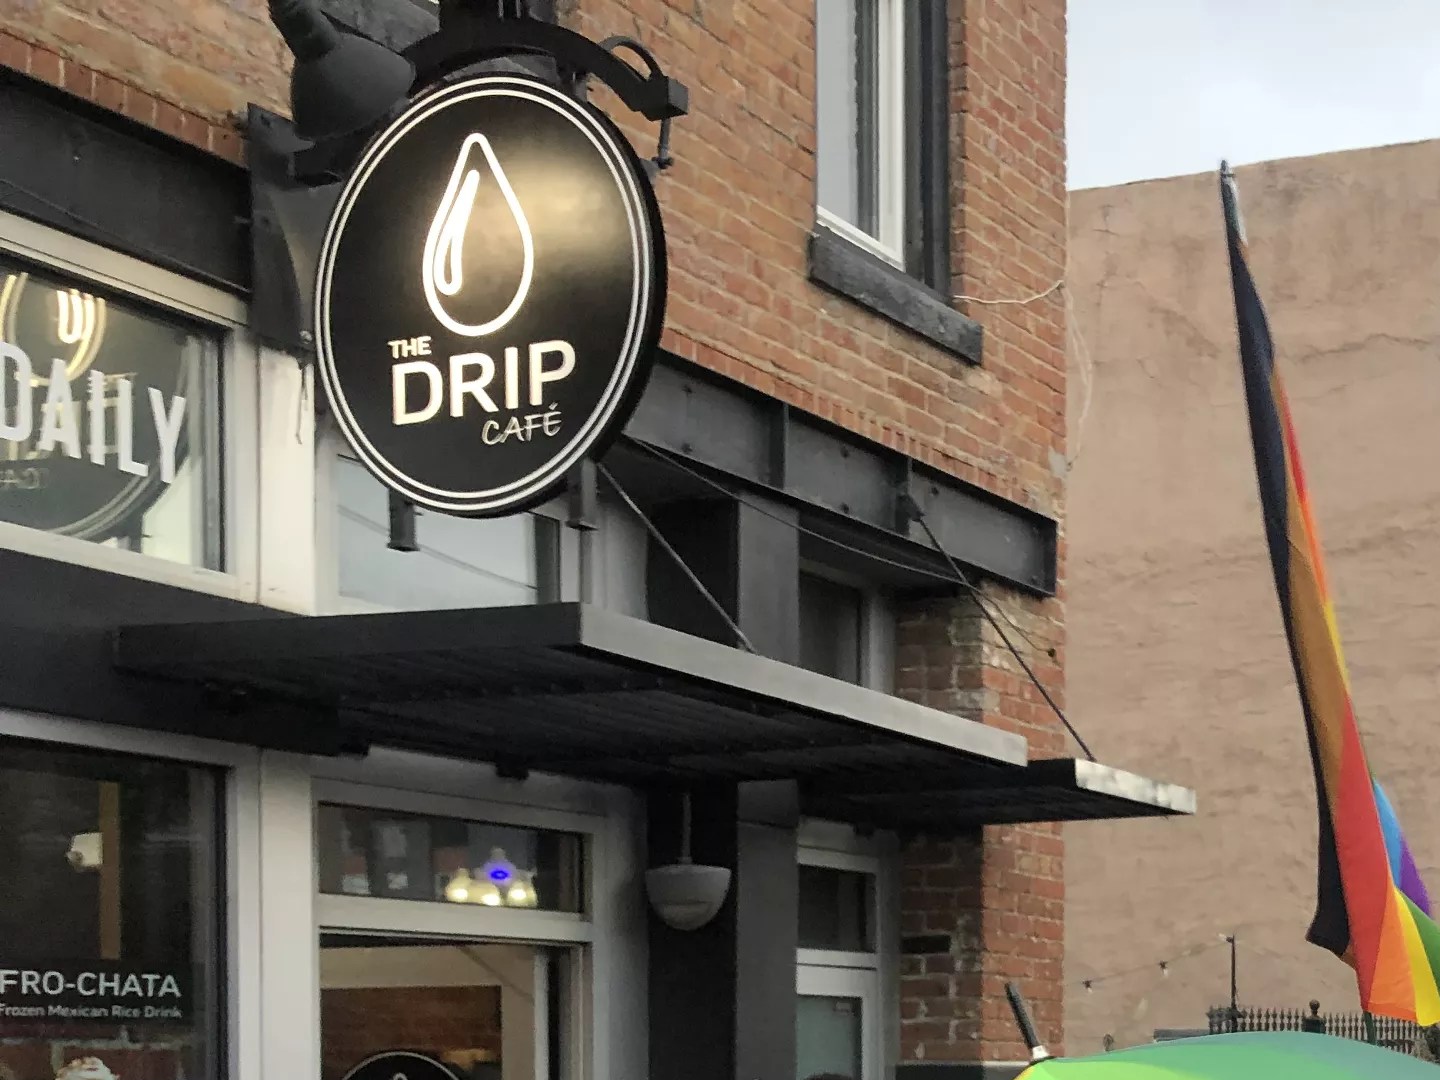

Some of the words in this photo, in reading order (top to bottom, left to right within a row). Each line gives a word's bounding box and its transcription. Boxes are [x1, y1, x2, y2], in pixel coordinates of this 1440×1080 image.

[388, 335, 432, 359] THE
[392, 339, 576, 426] DRIP
[0, 341, 187, 484] DAILY
[481, 402, 562, 445] CAFÉ
[0, 969, 182, 998] FRO-CHATA
[47, 1004, 109, 1018] Mexican
[111, 1005, 140, 1018] Rice
[143, 1006, 183, 1019] Drink
